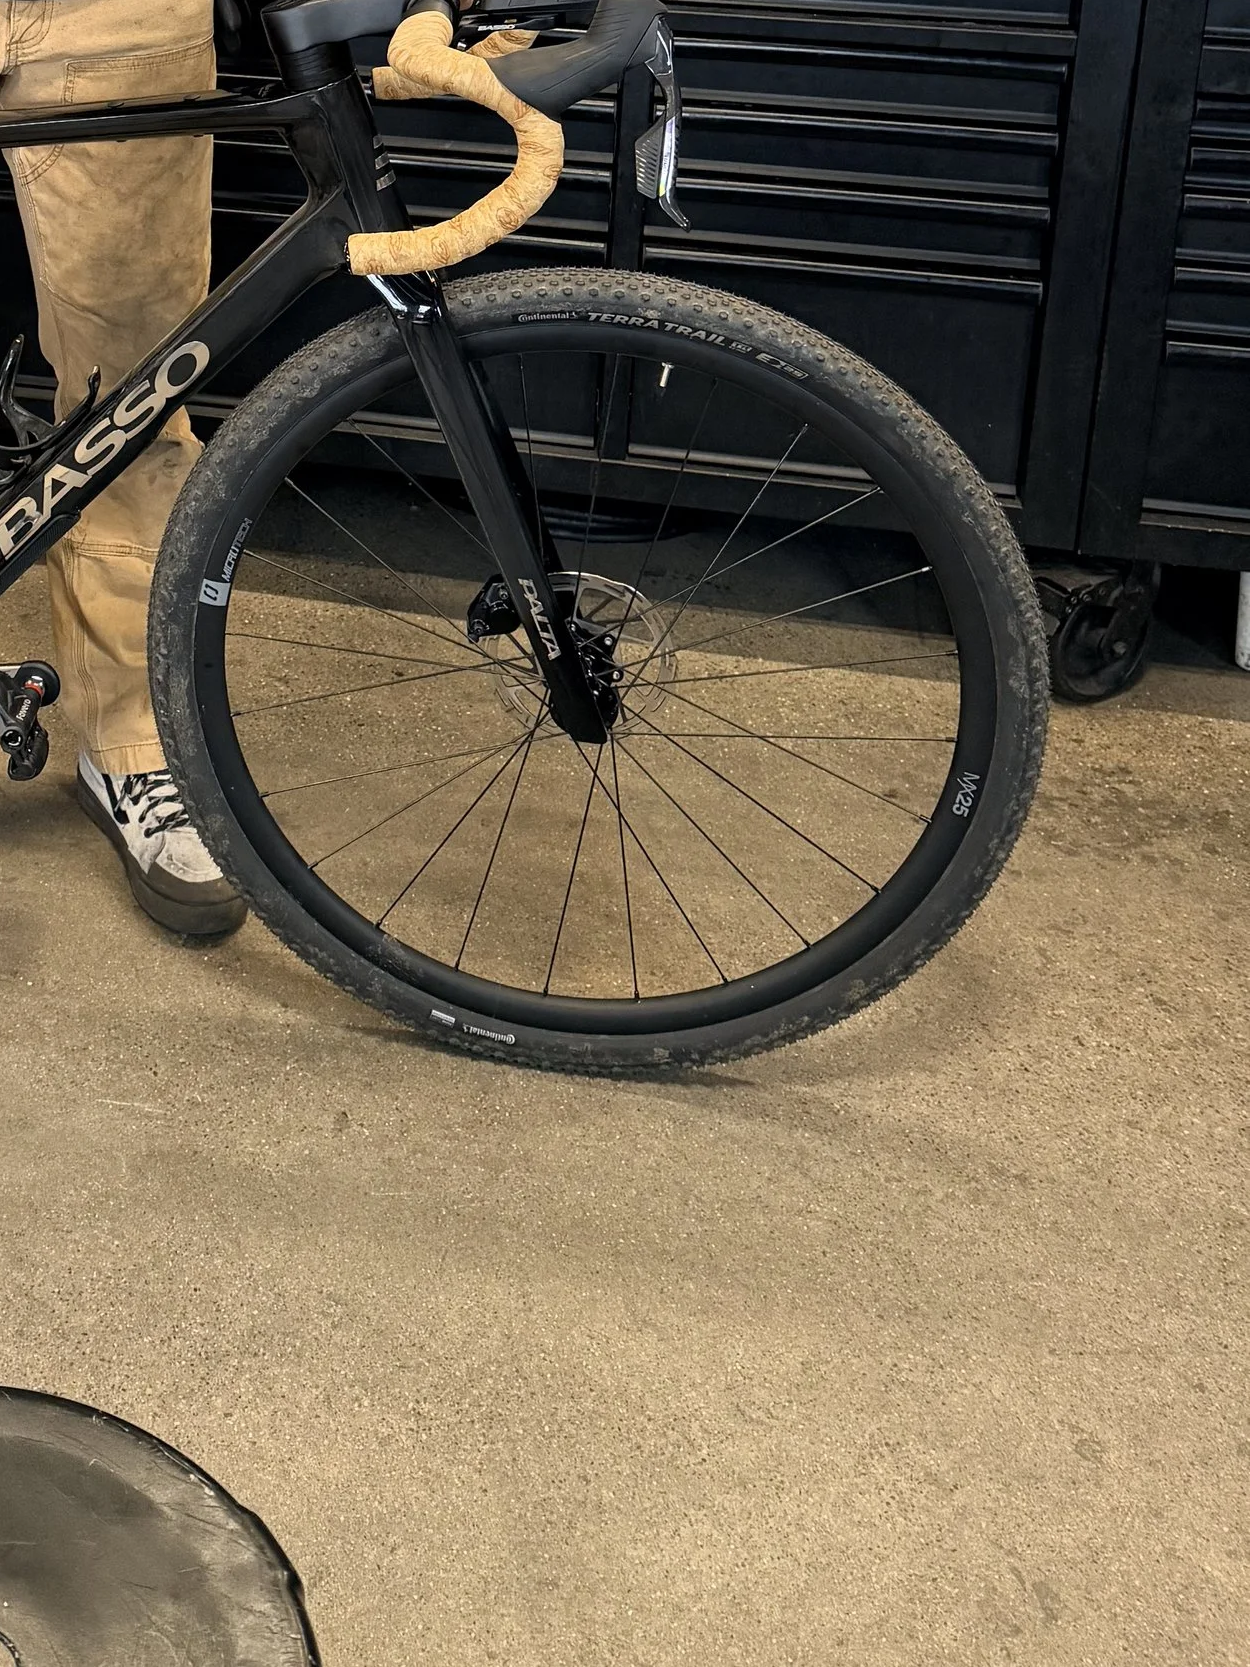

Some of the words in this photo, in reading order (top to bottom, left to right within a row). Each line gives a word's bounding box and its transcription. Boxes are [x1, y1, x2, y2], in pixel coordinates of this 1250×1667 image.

[478, 24, 516, 32] BASSO
[517, 312, 570, 324] Continental
[587, 312, 660, 330] TERRA
[664, 322, 726, 347] TRAIL
[221, 517, 253, 582] MICROTECH
[517, 578, 562, 661] PALTA
[952, 771, 981, 818] MX25
[469, 1025, 516, 1045] Continental
